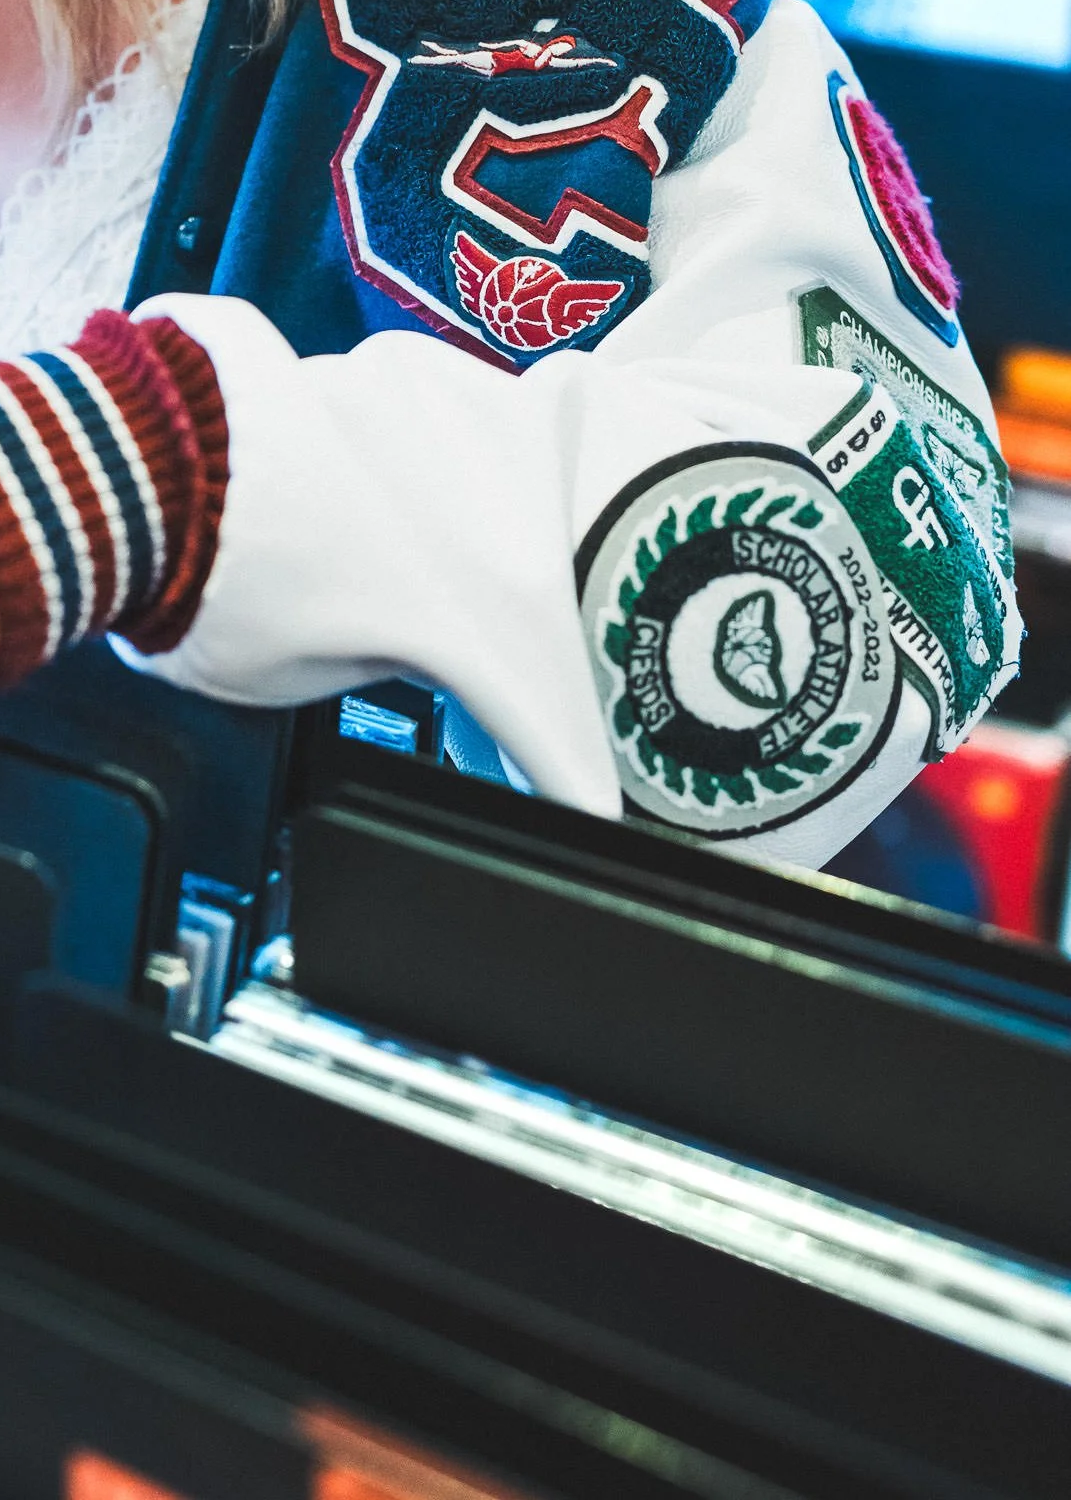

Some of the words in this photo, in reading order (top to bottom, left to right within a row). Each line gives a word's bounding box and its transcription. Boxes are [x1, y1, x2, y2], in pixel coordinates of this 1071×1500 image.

[839, 310, 976, 436] CHAMPIONSHIPS
[732, 530, 841, 628] SCHOLAR
[760, 637, 846, 757] ATHLETE
